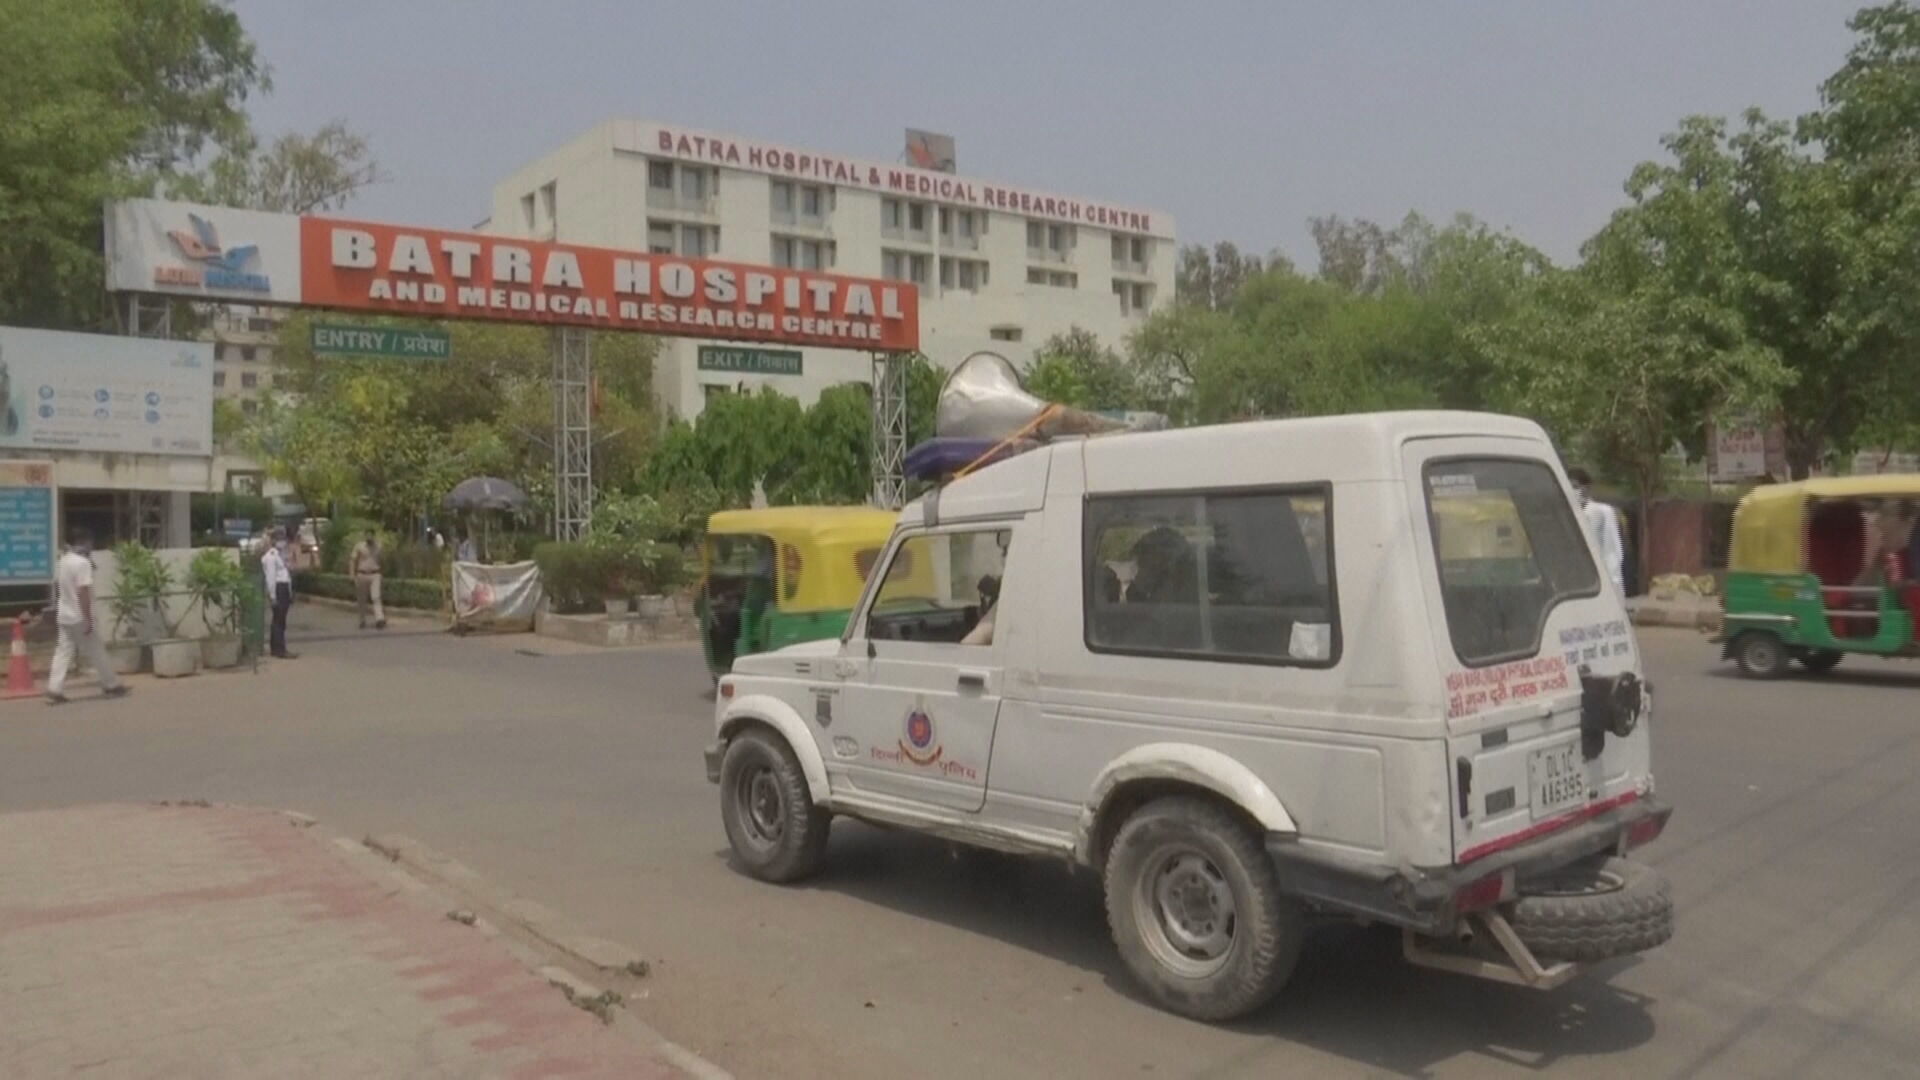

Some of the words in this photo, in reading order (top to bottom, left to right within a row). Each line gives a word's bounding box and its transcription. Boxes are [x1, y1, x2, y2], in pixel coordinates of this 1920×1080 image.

[658, 130, 740, 163] BATRA
[749, 147, 860, 183] HOSPITAL
[868, 167, 881, 185] &
[889, 171, 977, 202] MEDICAL
[984, 187, 1080, 219] RESEARCH
[1086, 206, 1150, 231] CENTRE
[331, 228, 584, 289] BATRA
[613, 258, 904, 319] HOSPITAL
[369, 278, 446, 304] AND
[458, 286, 610, 317] MEDICAL
[620, 302, 775, 331] RESEARCH
[783, 315, 882, 340] CENTRE
[315, 327, 385, 350] ENTRY
[402, 333, 447, 355] प्रवेश
[702, 351, 743, 366] EXIT
[1546, 749, 1573, 778] DL1C
